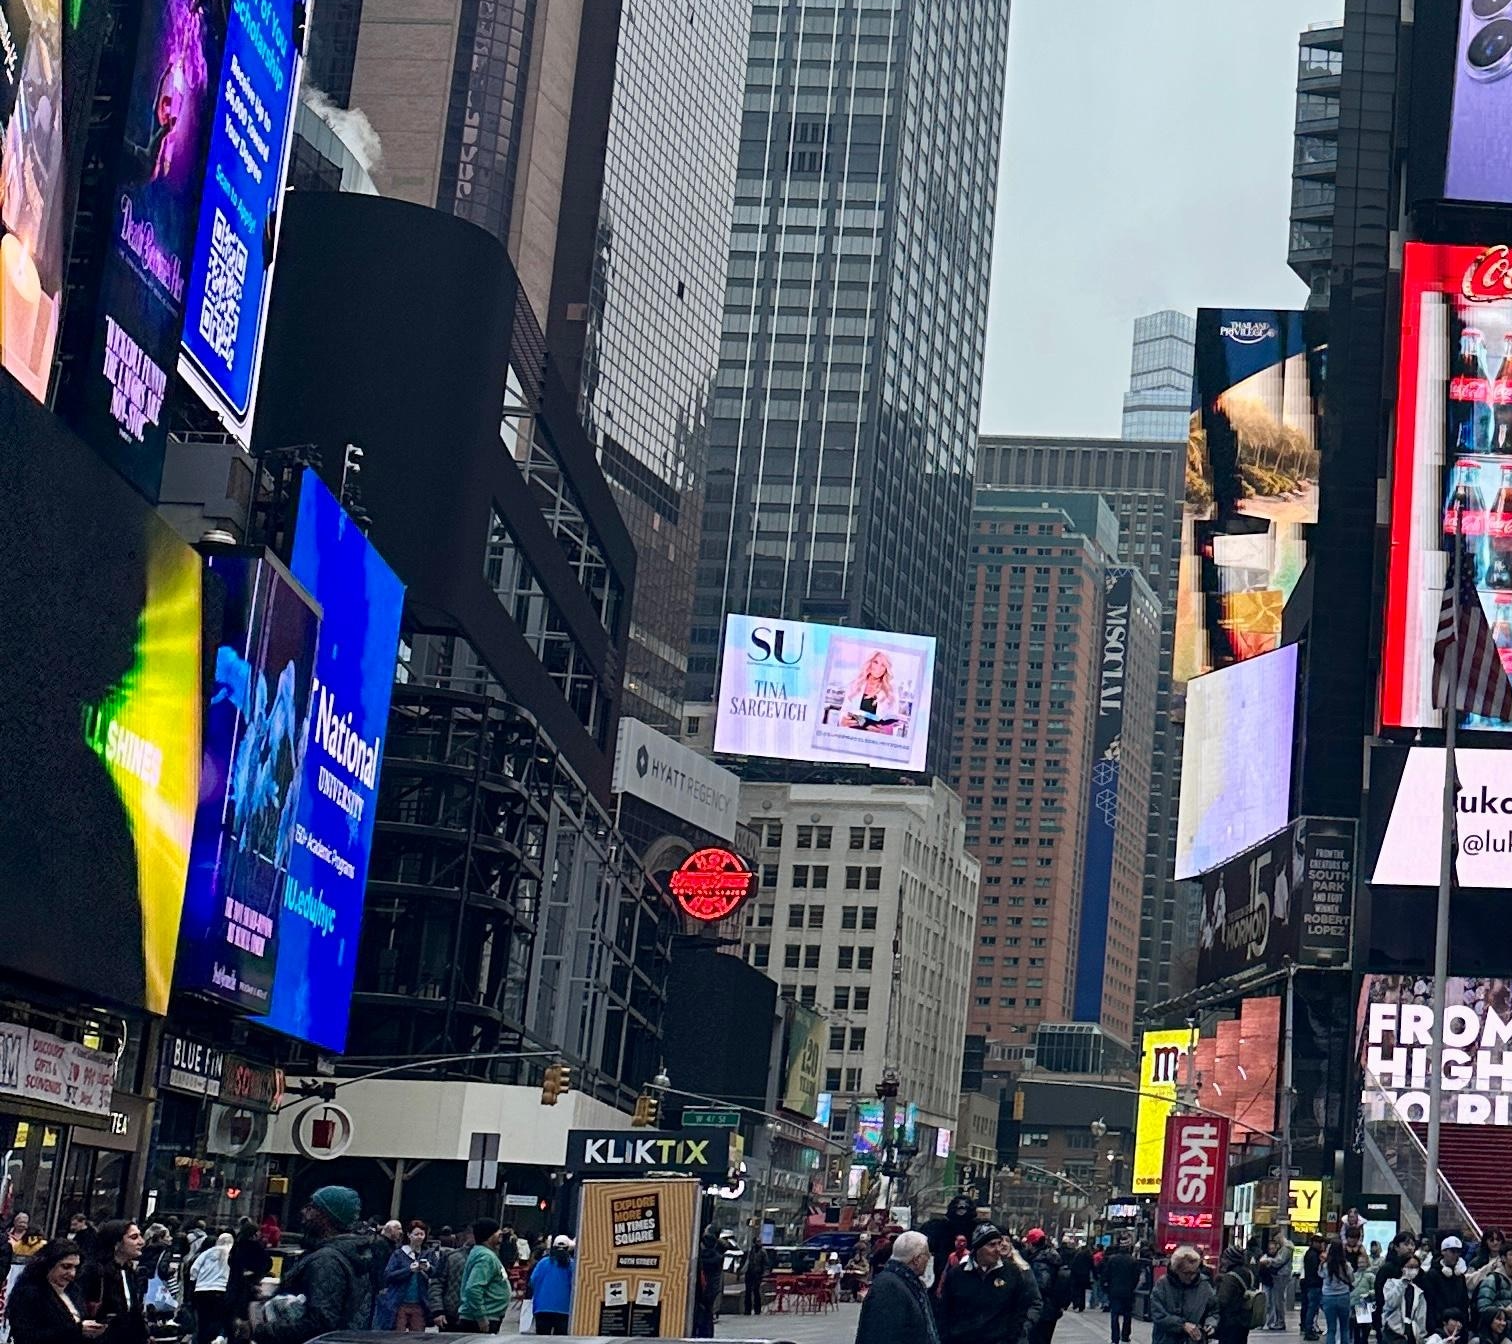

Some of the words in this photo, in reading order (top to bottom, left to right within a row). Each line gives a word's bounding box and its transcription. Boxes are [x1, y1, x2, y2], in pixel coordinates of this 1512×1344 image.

[271, 9, 288, 58] You
[747, 626, 806, 666] SU
[754, 679, 788, 702] TINA
[729, 696, 808, 723] SARCEVICH
[314, 685, 380, 791] National
[318, 765, 365, 823] UNIVERSITY
[651, 759, 687, 793] HYATT
[687, 777, 732, 815] REGENCY
[1308, 870, 1351, 881] SOUTH
[1312, 881, 1345, 893] PARK
[1303, 913, 1351, 925] ROBERT
[1307, 925, 1346, 937] LOPEZ
[173, 1038, 203, 1071] BLUE
[111, 1113, 129, 1136] TEA
[584, 1138, 709, 1165] KLIKTIX
[1176, 1122, 1219, 1205] tkts
[613, 1195, 656, 1212] EXPLORE
[614, 1208, 642, 1223] MORE
[614, 1222, 626, 1234] IN
[626, 1217, 656, 1233] TIMES
[614, 1230, 655, 1246] SQUARE
